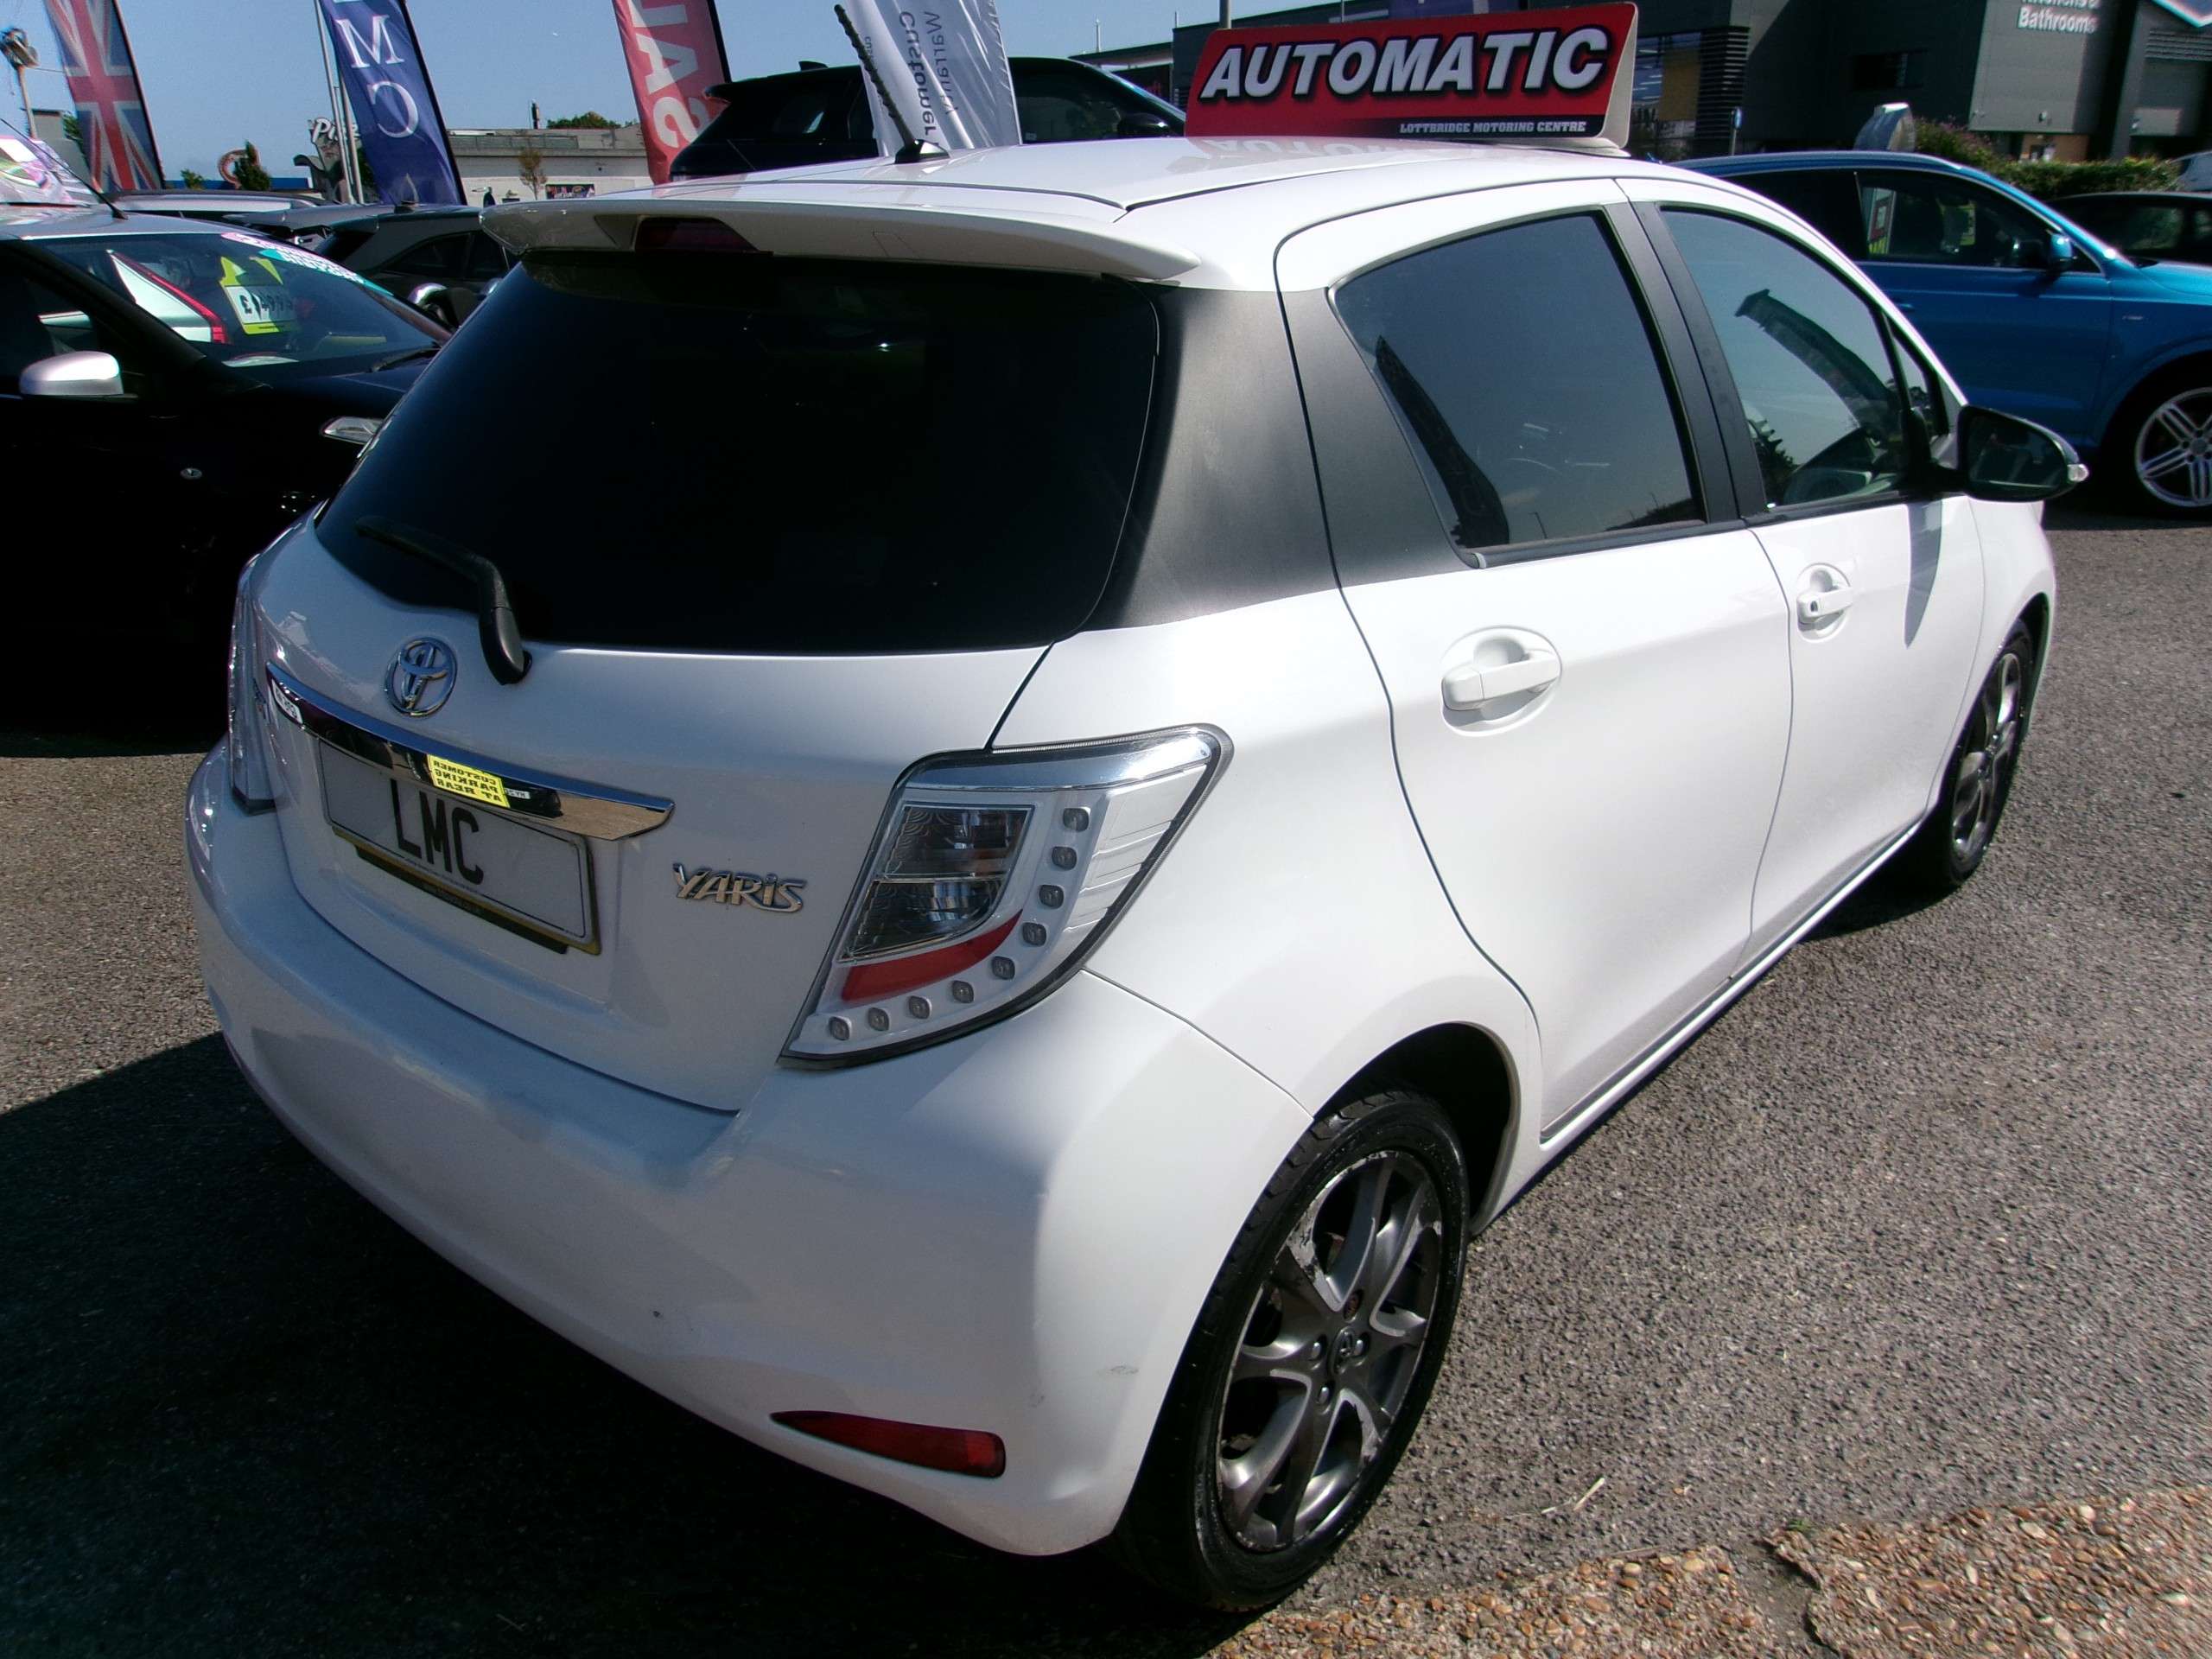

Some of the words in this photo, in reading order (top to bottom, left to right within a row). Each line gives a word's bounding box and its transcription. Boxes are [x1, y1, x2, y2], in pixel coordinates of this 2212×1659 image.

[2018, 5, 2099, 34] Bathrooms
[1198, 27, 1610, 100] AUTOMATIC
[1400, 122, 1471, 134] LOTTBRIDGE
[1472, 121, 1535, 133] MOTORING
[1536, 121, 1587, 132] CENTRE
[390, 779, 484, 885] LMC
